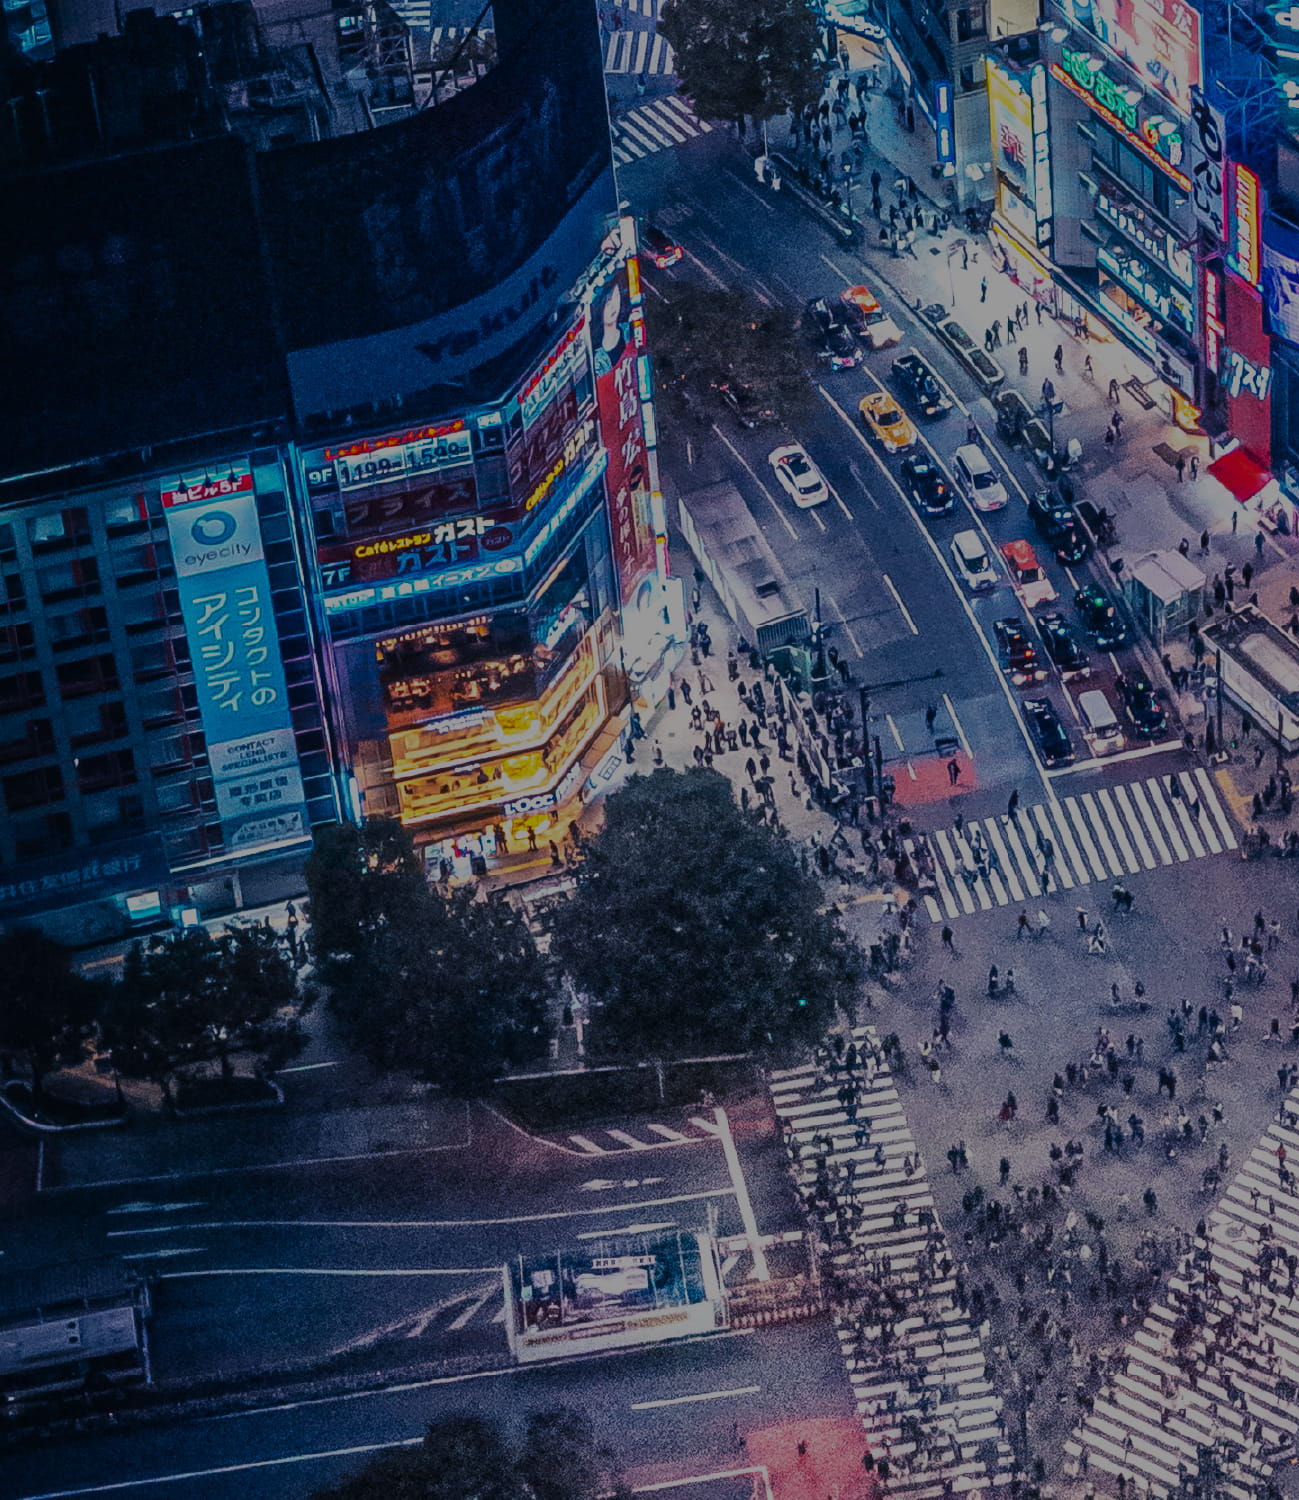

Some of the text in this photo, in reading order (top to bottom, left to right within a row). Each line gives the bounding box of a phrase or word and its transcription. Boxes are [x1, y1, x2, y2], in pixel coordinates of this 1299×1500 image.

[309, 467, 332, 485] 9F
[434, 516, 495, 545] ガスト
[184, 543, 252, 567] eyecity
[397, 541, 471, 574] ガスト
[323, 567, 351, 585] 7F
[192, 592, 243, 712] アイシティ
[235, 586, 277, 706] コンタクトの
